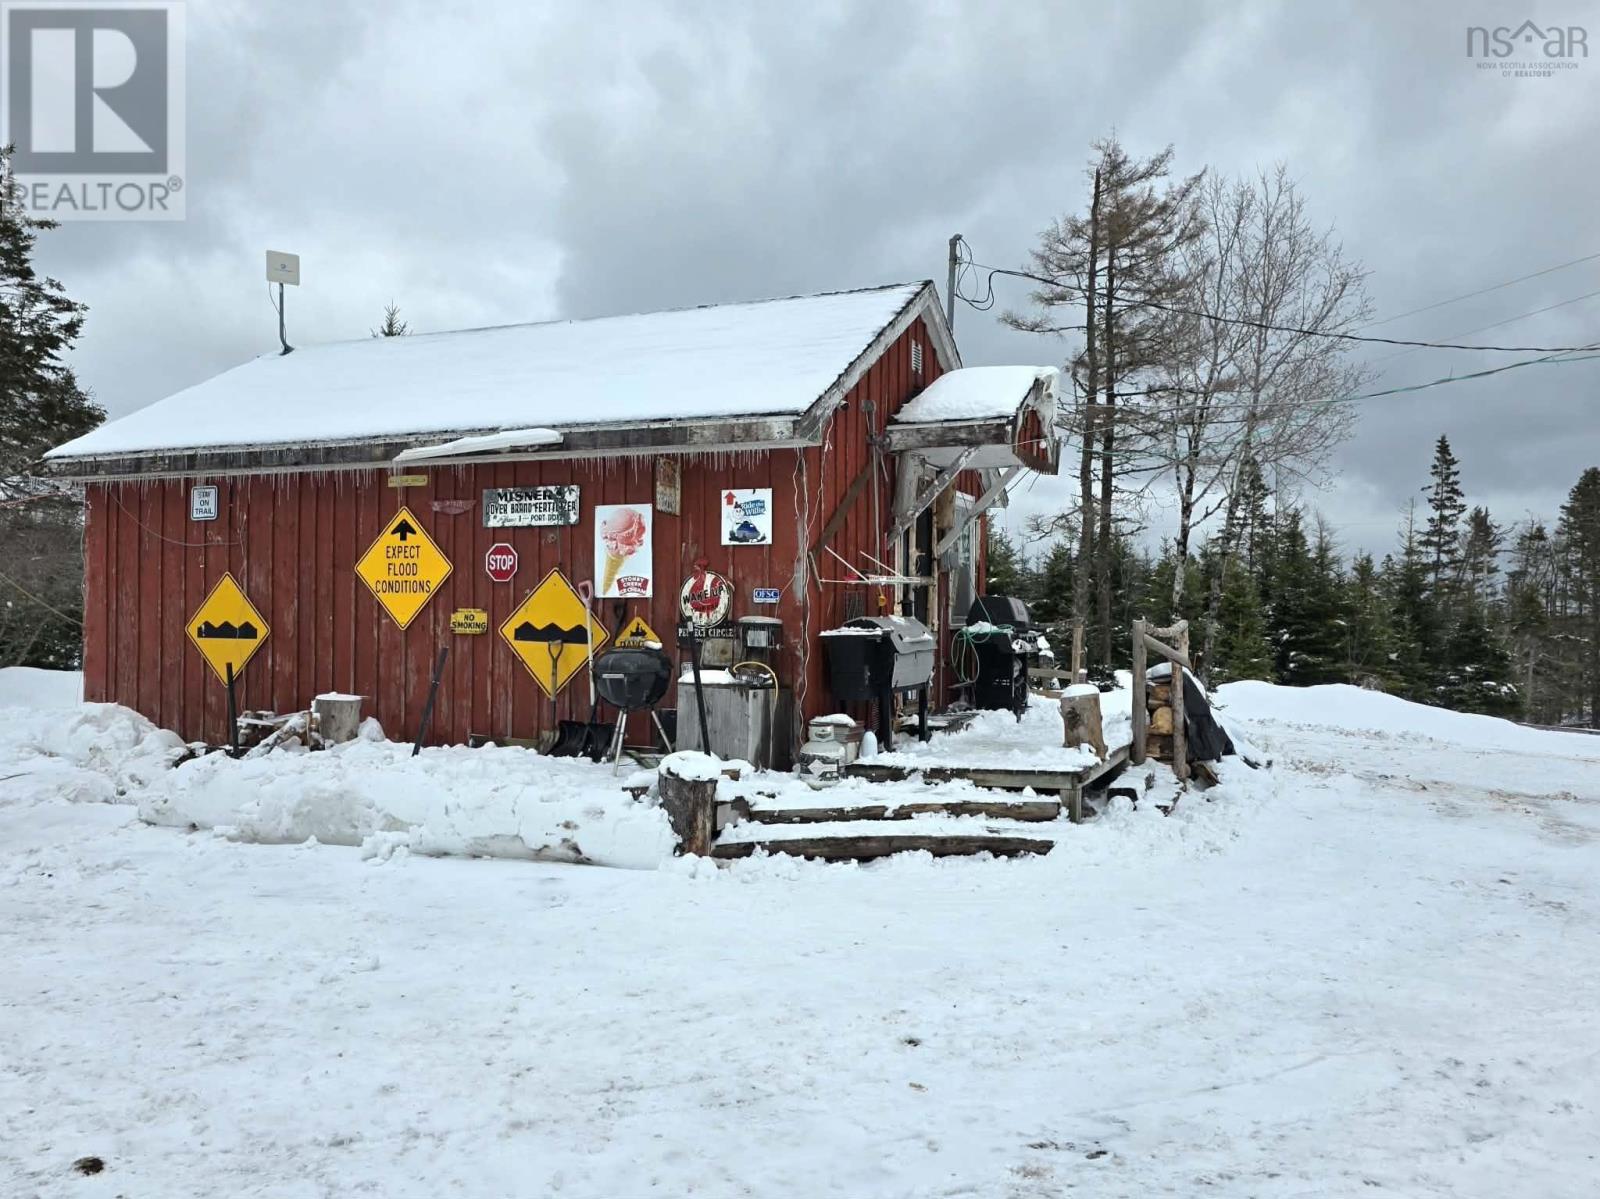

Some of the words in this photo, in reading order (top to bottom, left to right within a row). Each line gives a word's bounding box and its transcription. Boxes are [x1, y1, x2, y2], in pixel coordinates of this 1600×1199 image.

[199, 499, 210, 507] ON
[194, 507, 214, 515] TRAIL
[386, 545, 421, 559] EXPECT
[489, 555, 514, 570] STOP
[388, 563, 417, 576] FLOOD
[375, 580, 431, 593] CONDITIONS
[682, 589, 709, 605] WAKE
[711, 585, 724, 598] UP
[755, 590, 777, 598] OFSC
[451, 621, 486, 630] SMOKING
[678, 628, 706, 637] PEECT
[708, 628, 734, 638] CIRCLE
